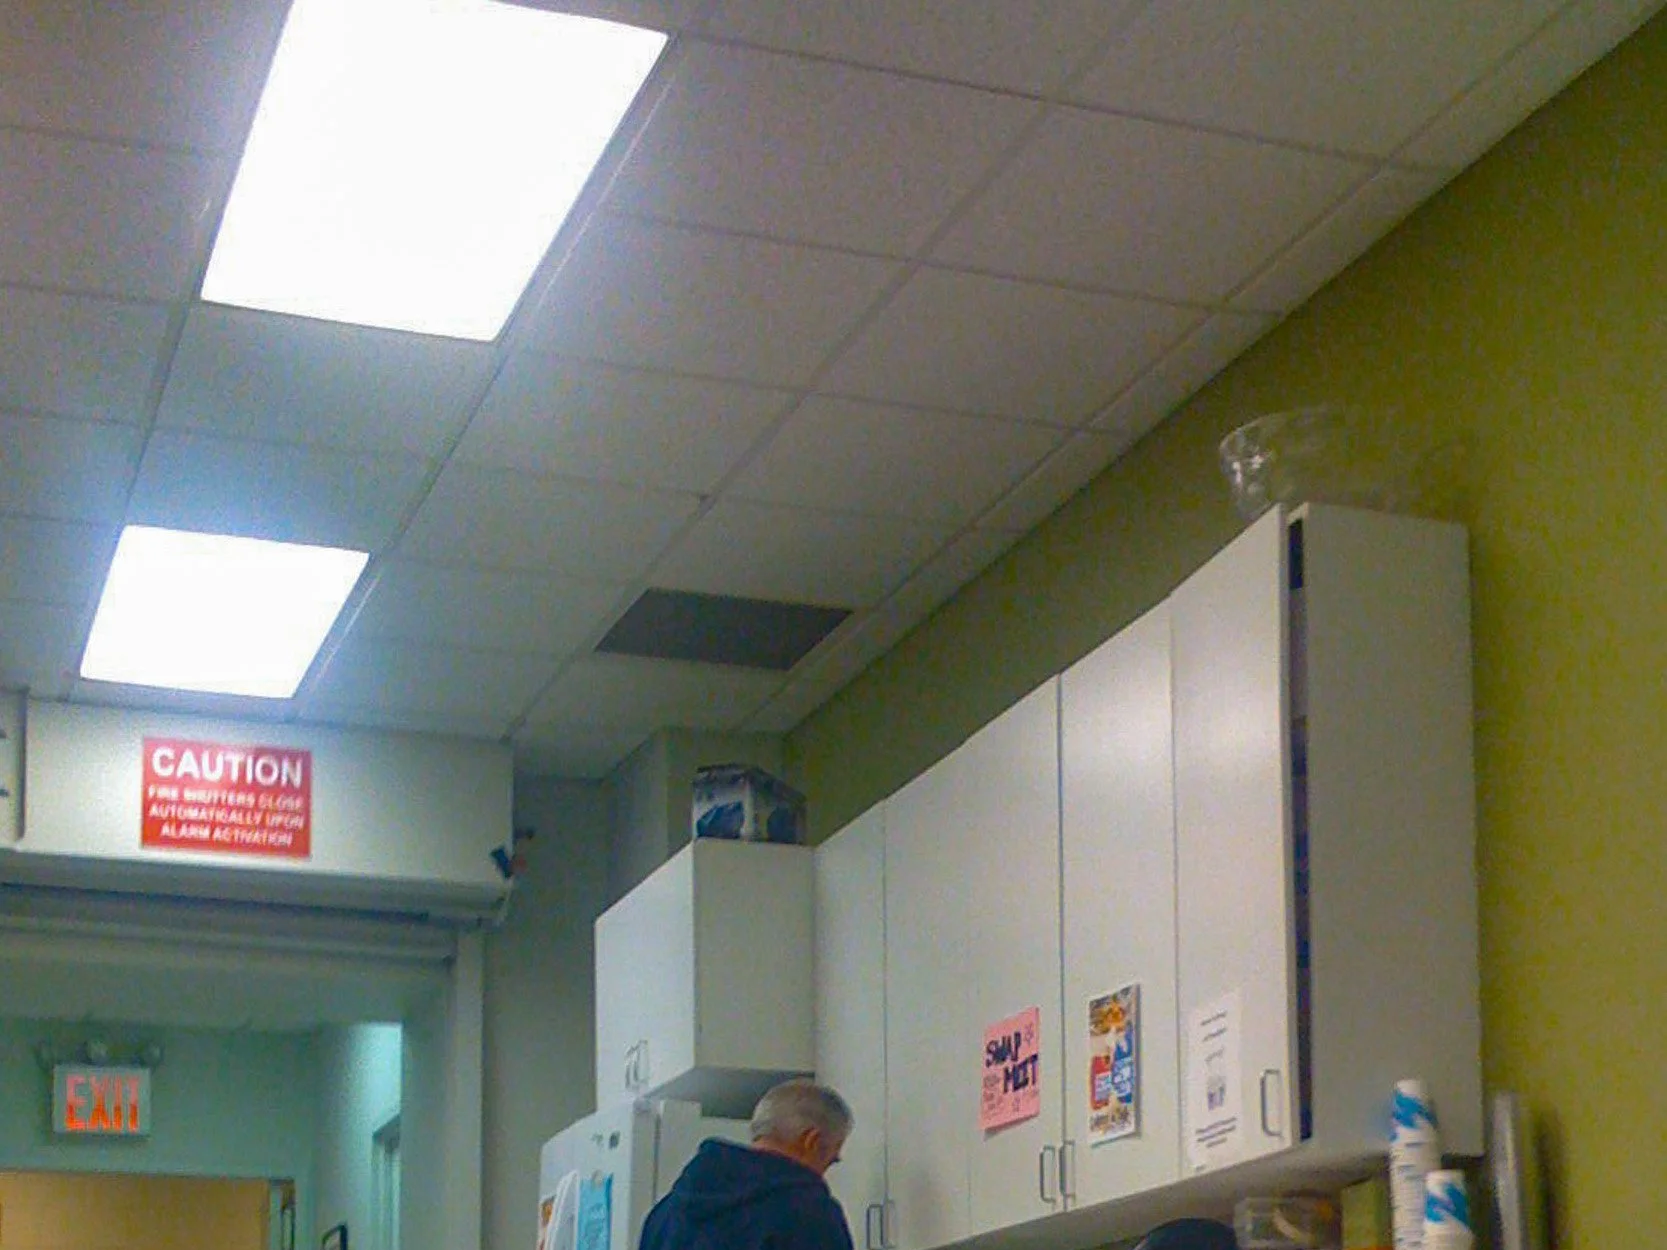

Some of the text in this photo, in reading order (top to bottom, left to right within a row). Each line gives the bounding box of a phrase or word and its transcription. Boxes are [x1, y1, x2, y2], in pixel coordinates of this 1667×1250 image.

[152, 746, 303, 789] CAUTION
[149, 804, 262, 826] AUTOMATICALLY
[160, 822, 293, 847] ALARM ACTIVATION
[65, 1073, 140, 1134] EXIT
